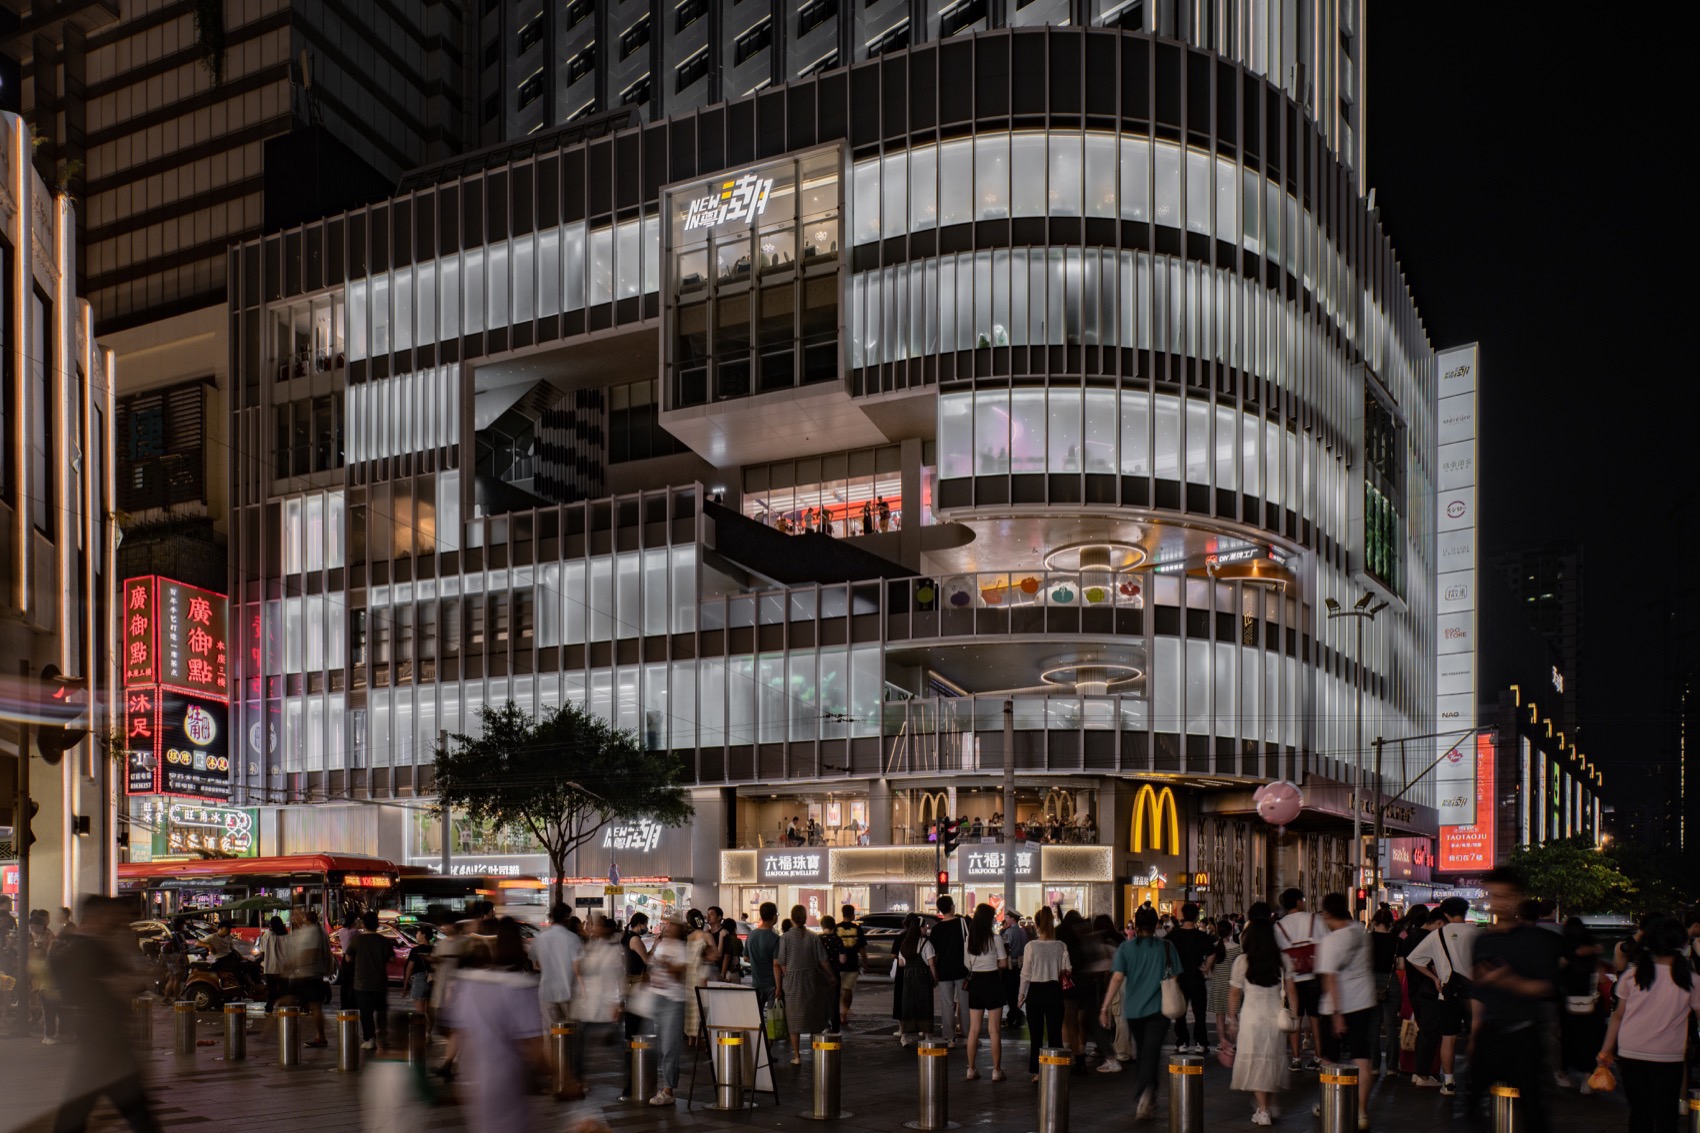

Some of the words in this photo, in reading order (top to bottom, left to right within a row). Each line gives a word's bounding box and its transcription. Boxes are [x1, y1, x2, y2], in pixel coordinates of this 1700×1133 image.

[688, 193, 721, 215] NEW
[187, 597, 213, 685] 廣御點
[130, 693, 151, 737] 沐足
[765, 855, 820, 871] 六福珠寶
